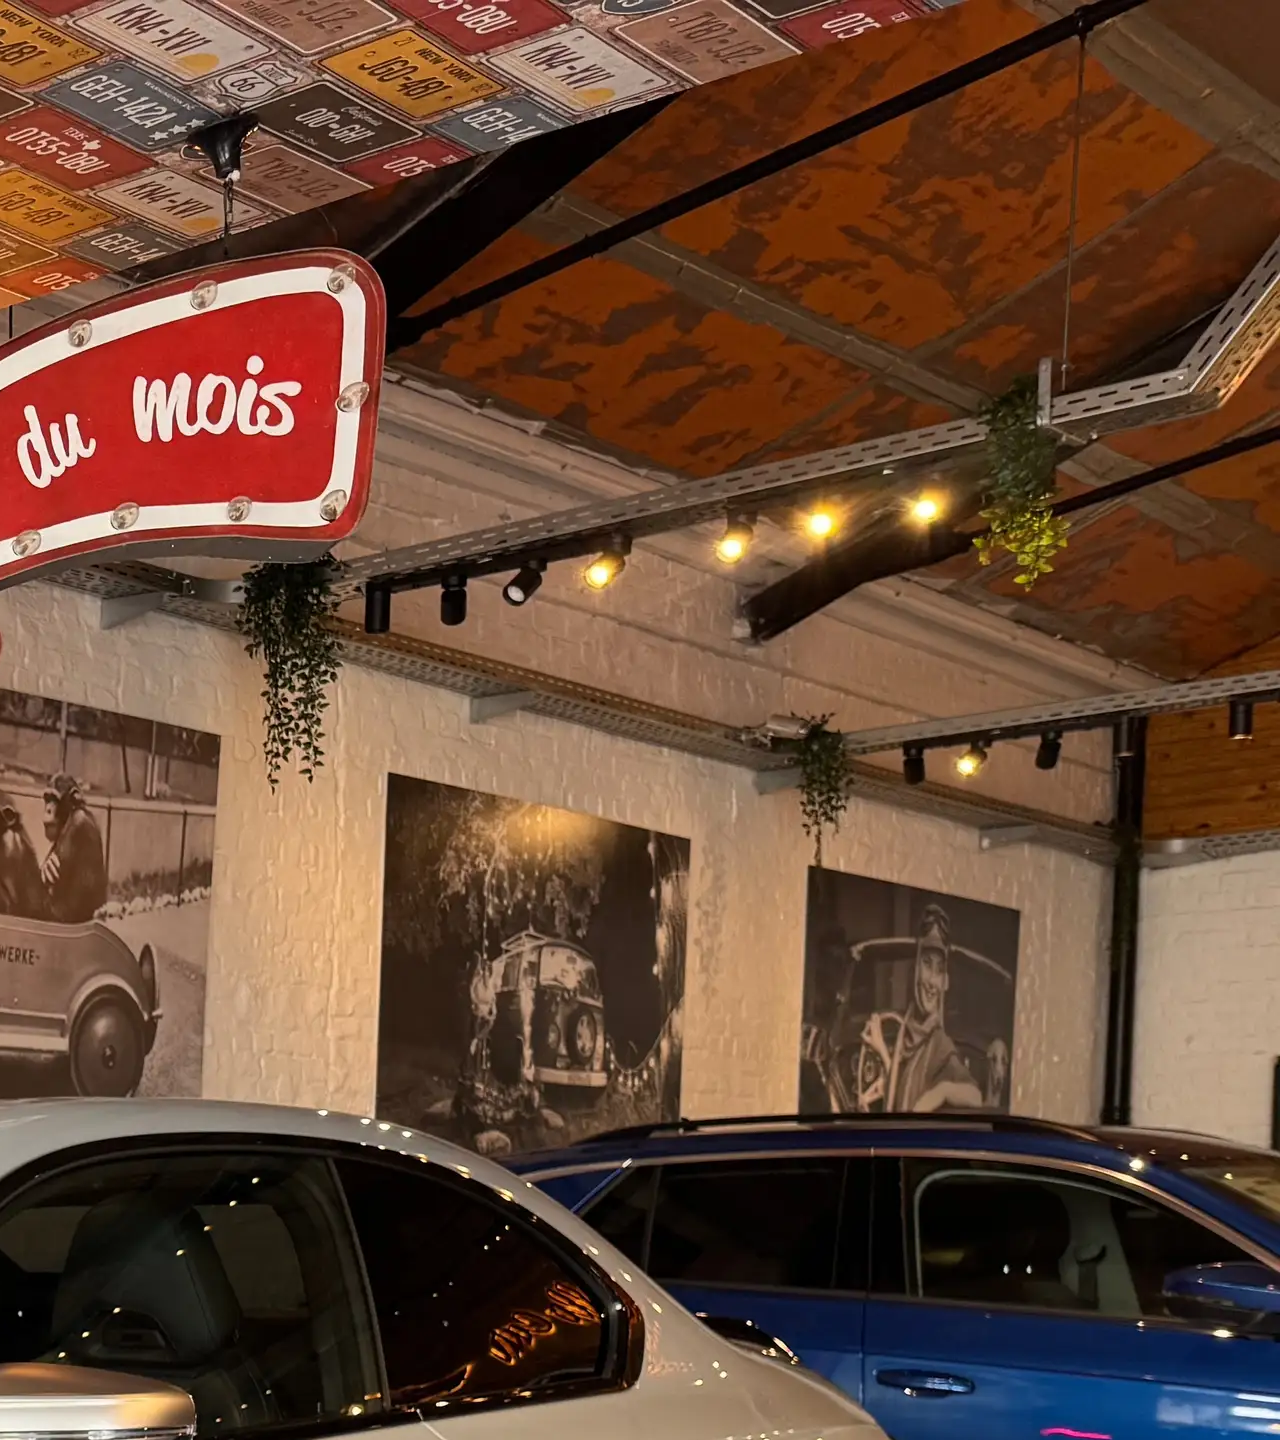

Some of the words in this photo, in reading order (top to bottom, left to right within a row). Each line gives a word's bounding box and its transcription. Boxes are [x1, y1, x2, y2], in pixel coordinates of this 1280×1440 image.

[227, 74, 268, 92] 66
[410, 46, 449, 66] NEW
[441, 64, 478, 82] YORK
[63, 73, 182, 127] GEH-142A
[17, 404, 96, 489] du
[134, 355, 302, 443] mois
